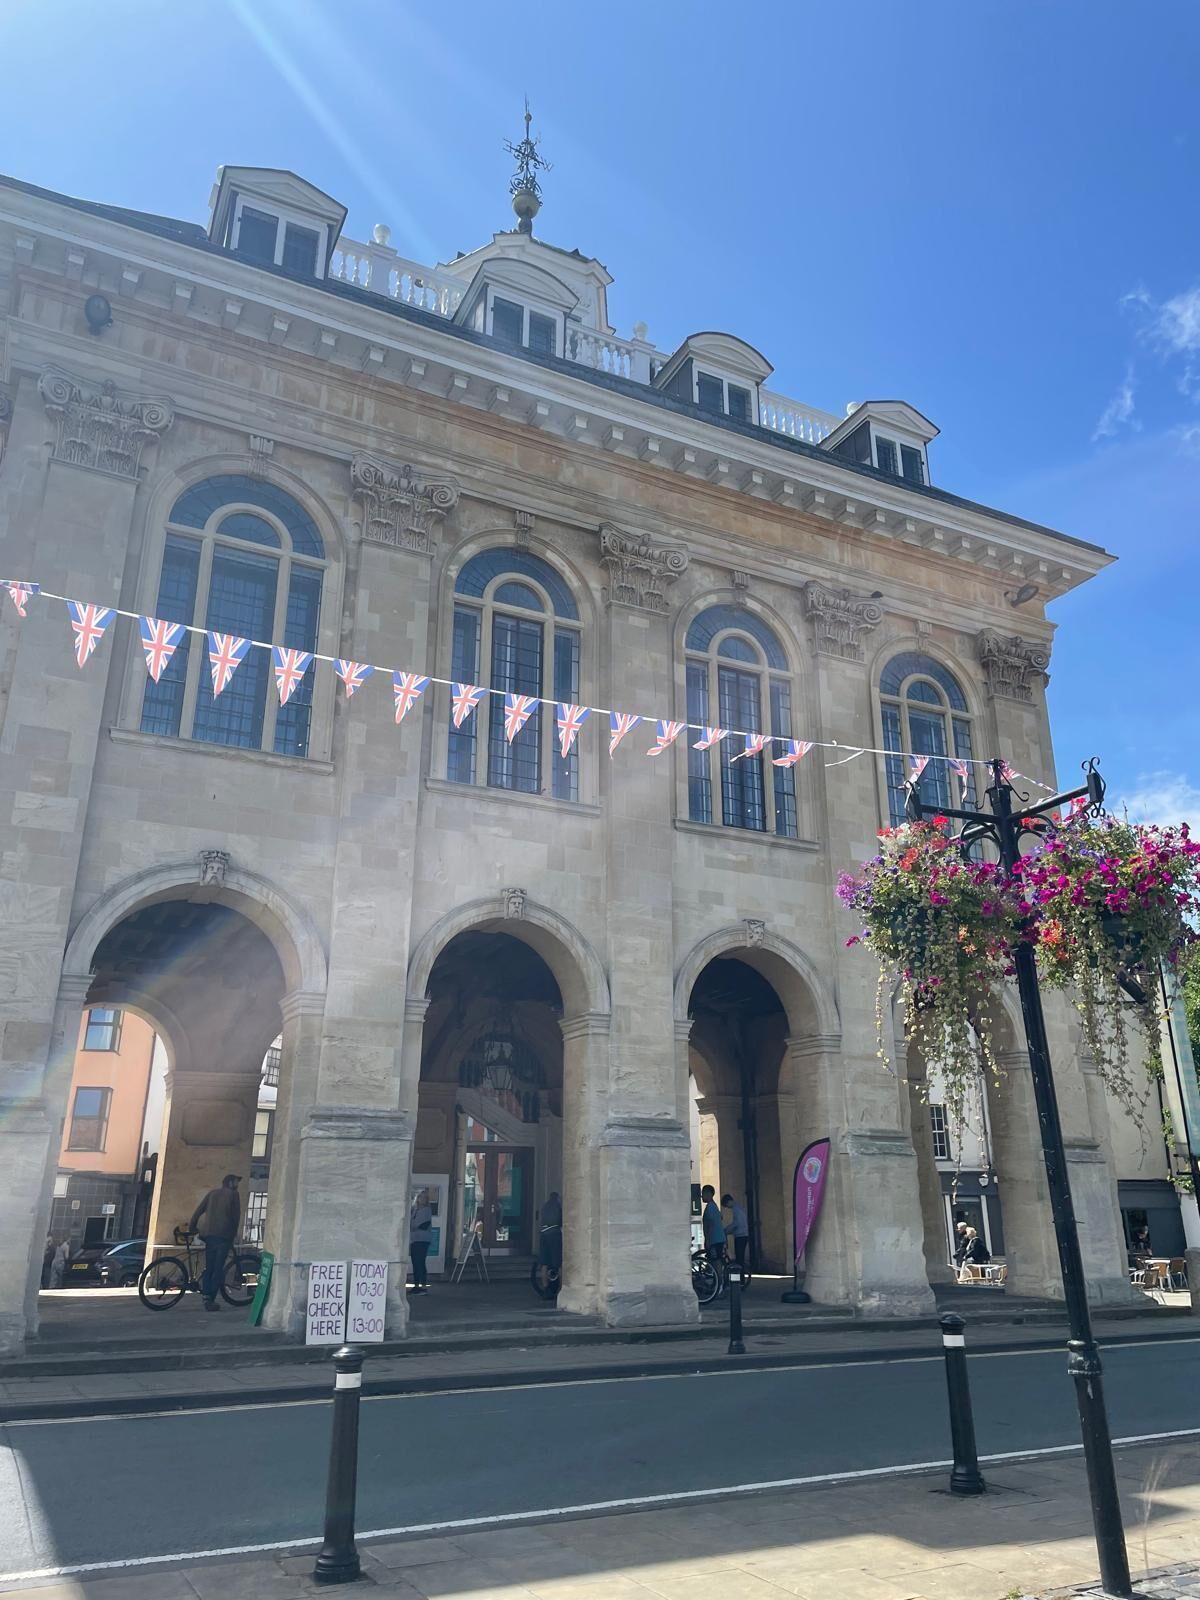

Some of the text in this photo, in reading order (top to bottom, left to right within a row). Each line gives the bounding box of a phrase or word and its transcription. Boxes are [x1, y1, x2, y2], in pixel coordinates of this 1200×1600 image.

[311, 1265, 344, 1280] FREE
[353, 1264, 387, 1279] TODAY
[313, 1283, 343, 1299] BIKE
[356, 1282, 385, 1297] 10:30
[308, 1302, 344, 1317] CHECK
[361, 1302, 374, 1312] TO
[311, 1320, 341, 1335] HERE
[353, 1318, 383, 1333] 13:00
